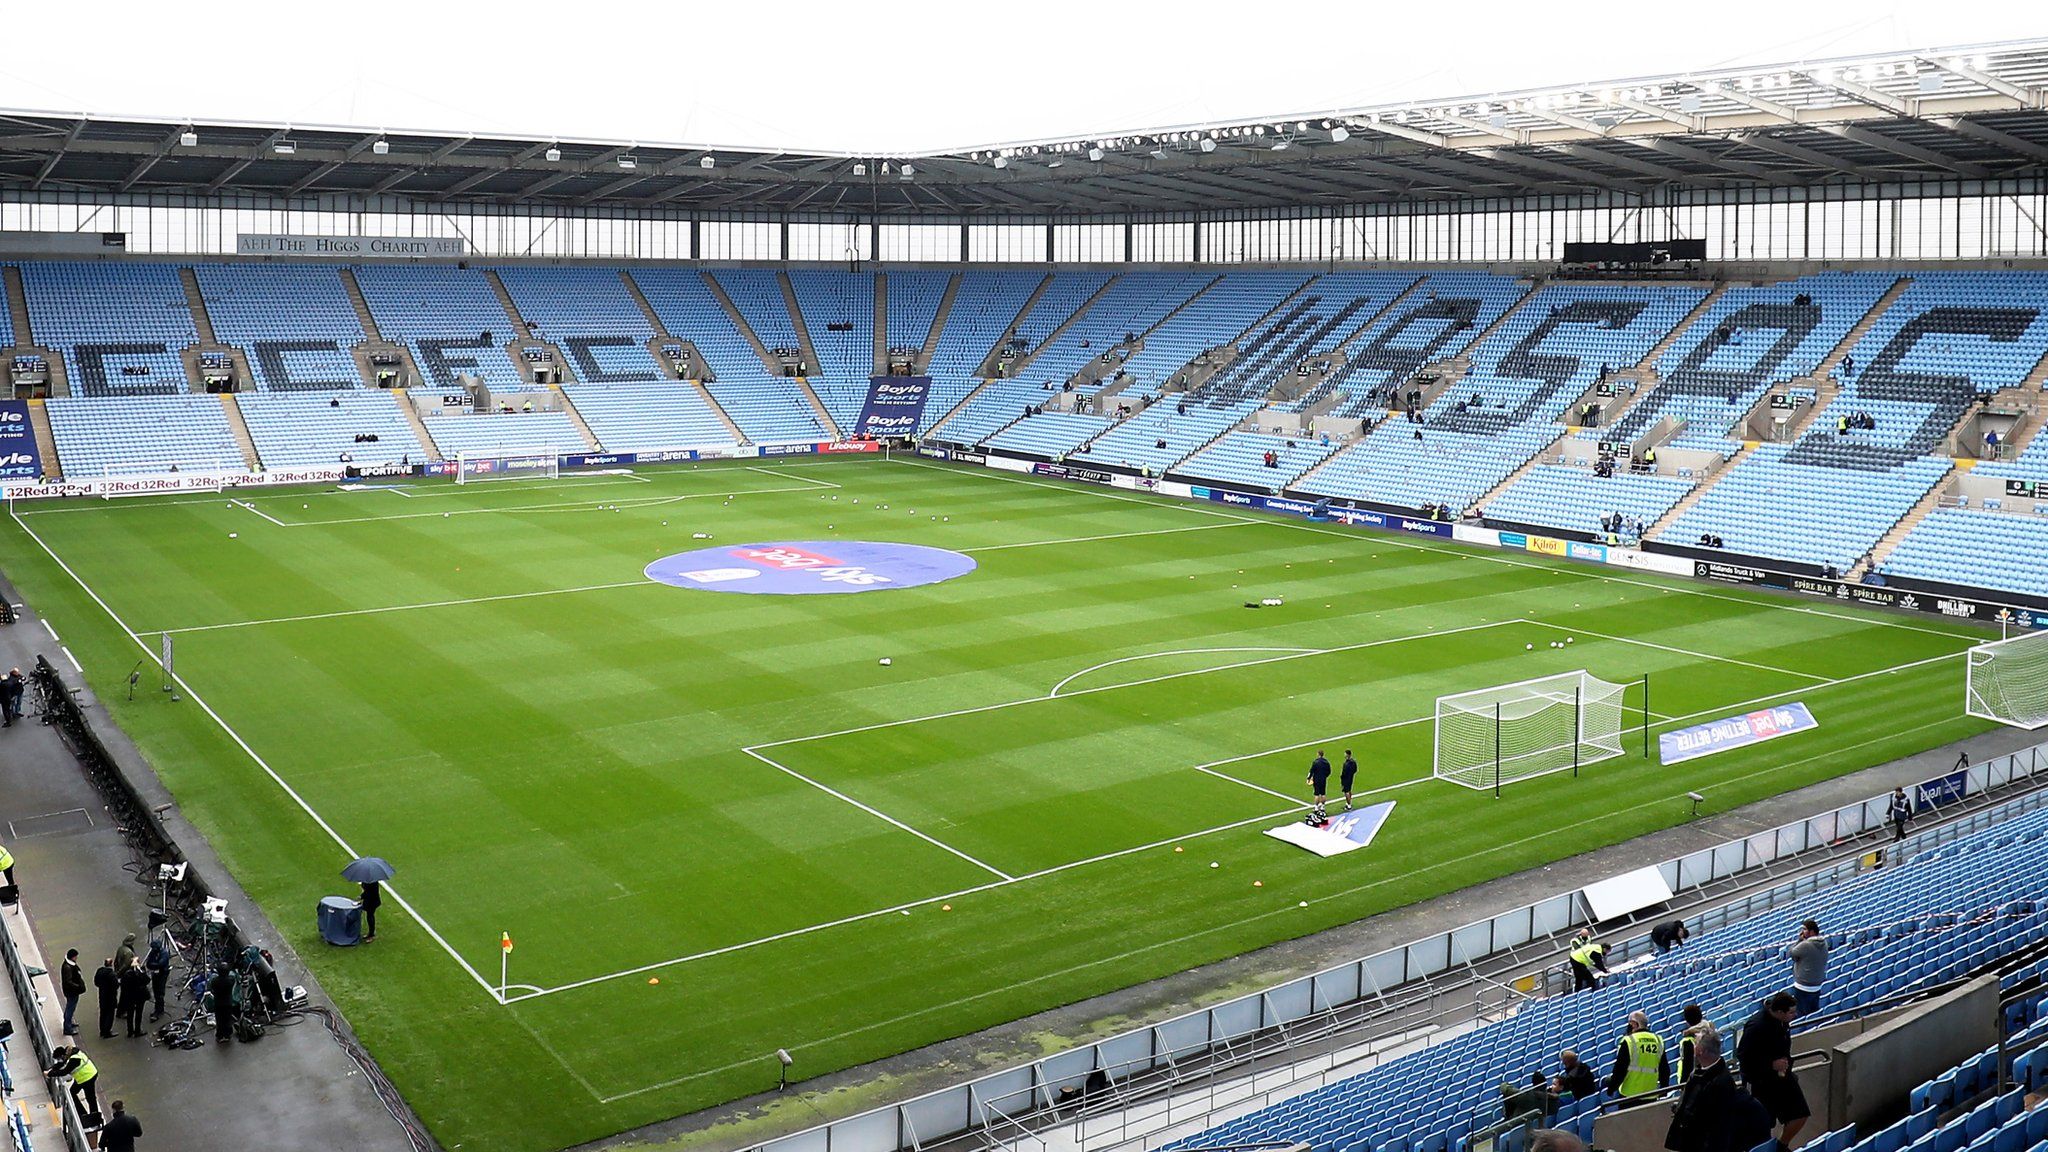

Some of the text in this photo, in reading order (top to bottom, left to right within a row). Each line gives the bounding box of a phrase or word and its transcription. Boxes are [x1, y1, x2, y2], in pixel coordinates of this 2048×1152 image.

[241, 238, 462, 253] AEH THE HIGGS CHARITY AEH
[877, 384, 924, 394] Boyle
[875, 393, 921, 401] Sports
[0, 411, 23, 422] le
[866, 415, 915, 426] Boyle
[866, 425, 912, 434] Sports
[785, 444, 812, 453] arena
[828, 442, 867, 451] Lifebuoy
[662, 451, 691, 461] arena
[965, 454, 985, 464] MOTORS
[360, 465, 412, 476] SPORTFIVE
[430, 463, 457, 475] sky bet
[464, 461, 491, 473] sky bet
[272, 472, 308, 482] 32Red
[309, 470, 345, 480] 32Red
[100, 481, 139, 492] 32Red
[141, 479, 180, 490] 32Red
[187, 477, 223, 487] 32Re
[7, 484, 49, 497] 32Red
[1266, 499, 1286, 511] Coventry
[1286, 502, 1304, 513] Building
[1327, 508, 1346, 519] oventry
[1365, 513, 1383, 524] Society
[1609, 553, 1649, 567] GENESIS
[749, 549, 892, 585] sky bet
[1709, 564, 1733, 574] Midlands
[1734, 567, 1748, 576] Truck
[1794, 580, 1816, 591] SPIRE
[1816, 584, 1833, 593] BAR
[1853, 588, 1876, 600] SPIRE
[1877, 593, 1894, 602] BAR
[1937, 600, 1976, 614] DHILLON'S
[1677, 710, 1795, 752] sky bet BETTING BETTER
[1639, 1044, 1658, 1054] 142
